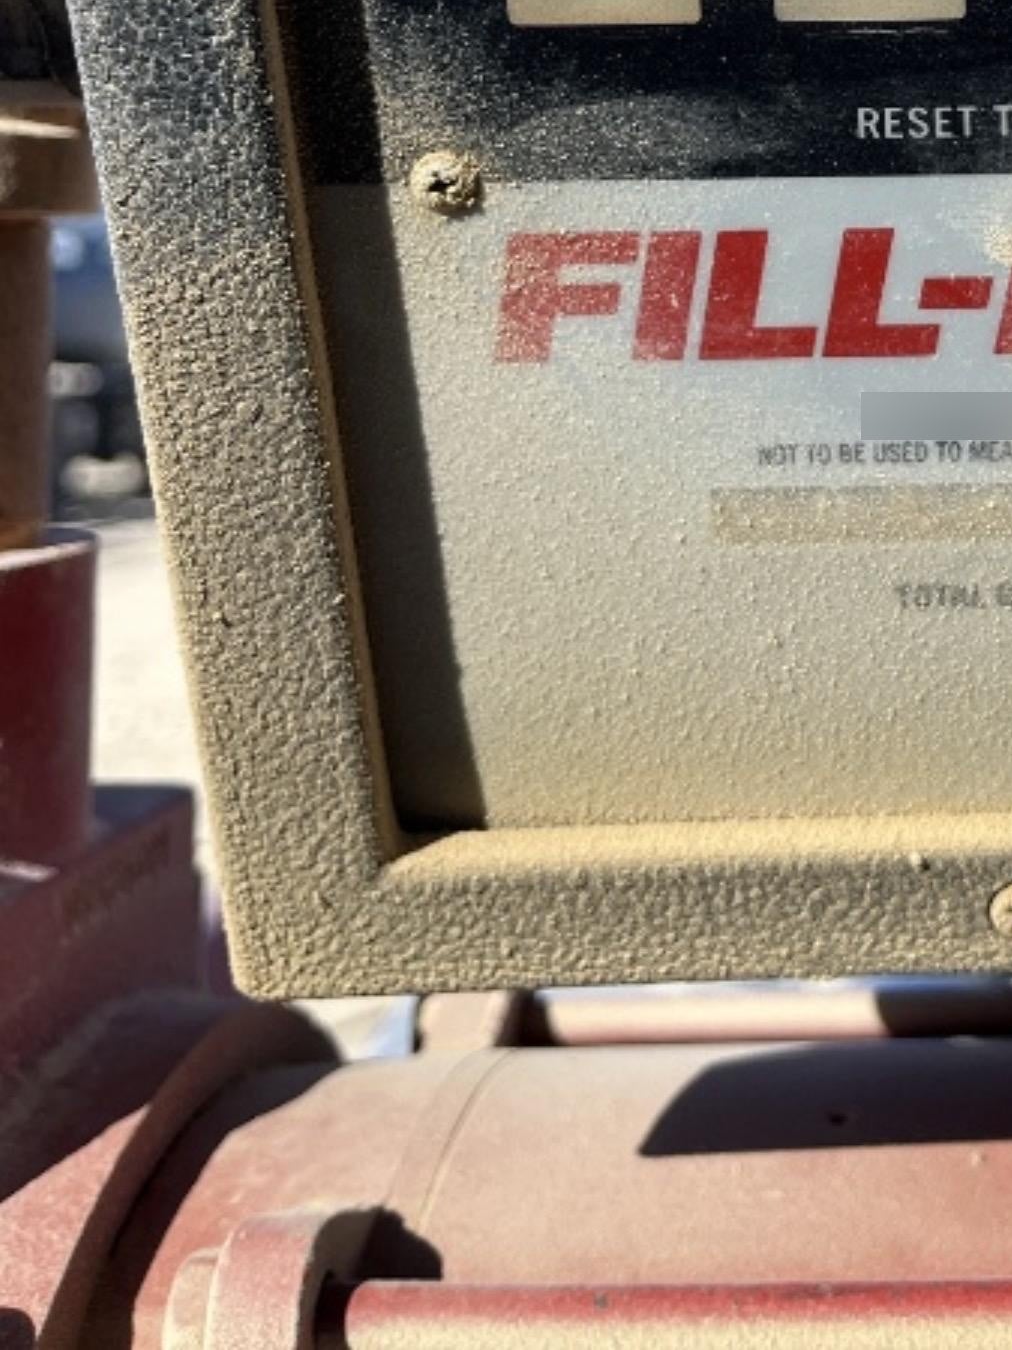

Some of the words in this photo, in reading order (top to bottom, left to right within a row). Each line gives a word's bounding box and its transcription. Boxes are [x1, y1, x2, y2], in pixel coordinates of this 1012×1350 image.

[856, 106, 977, 140] RESET
[757, 443, 798, 466] NOT
[803, 443, 832, 466] TO
[839, 442, 867, 465] BE
[873, 440, 929, 465] USED
[935, 440, 963, 464] TO
[894, 582, 984, 610] TOTAL
